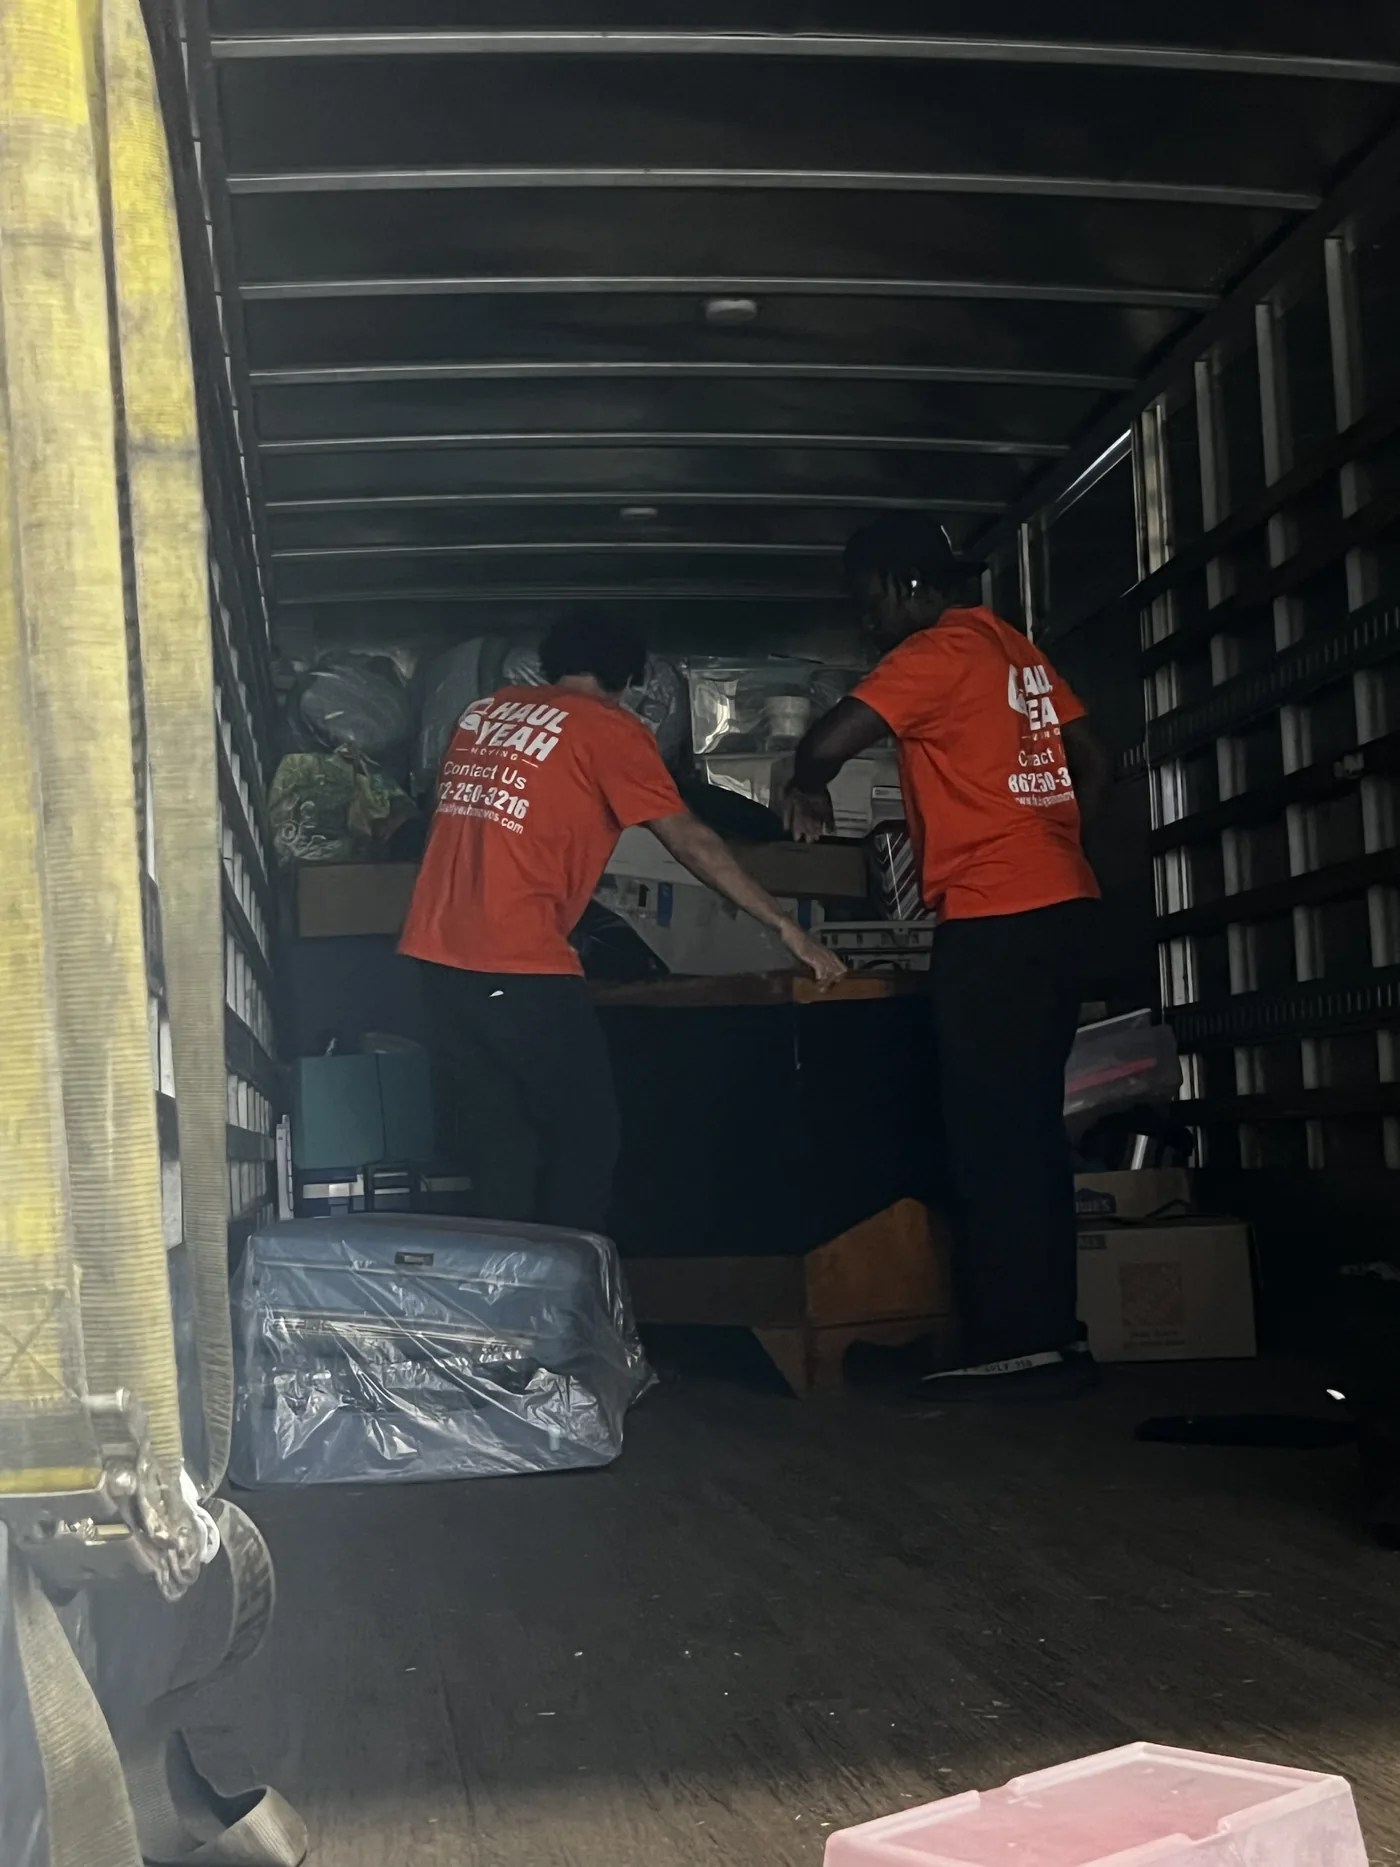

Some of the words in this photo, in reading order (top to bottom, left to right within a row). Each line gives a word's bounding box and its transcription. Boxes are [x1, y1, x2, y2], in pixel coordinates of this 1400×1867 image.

[489, 702, 570, 734] HAUL
[475, 721, 559, 762] YEAH
[444, 761, 499, 780] Contact
[501, 767, 527, 790] Us
